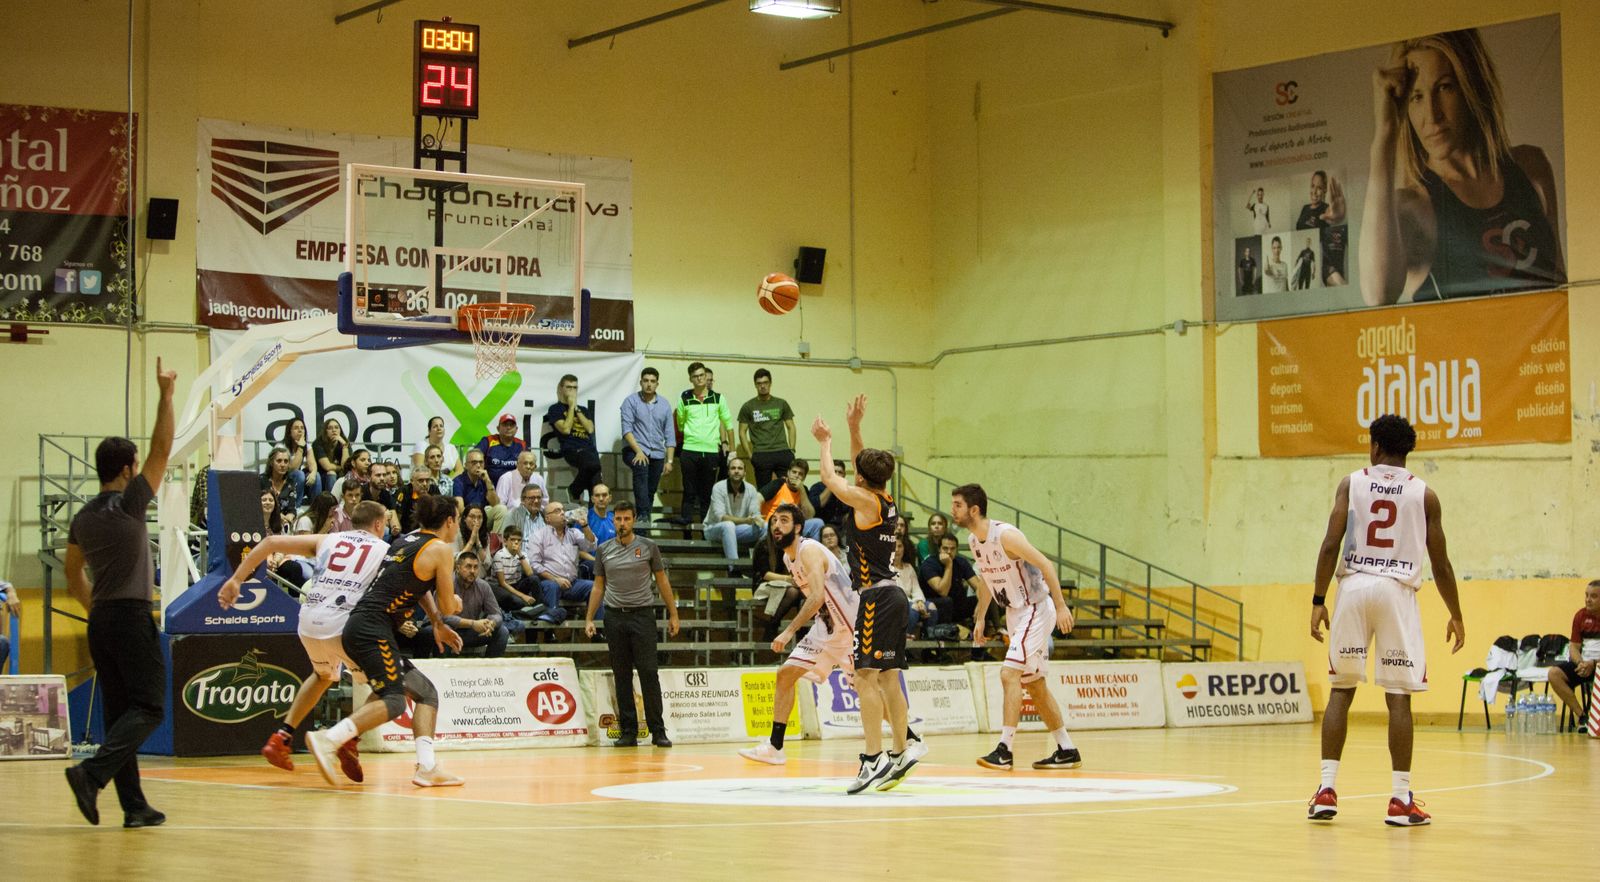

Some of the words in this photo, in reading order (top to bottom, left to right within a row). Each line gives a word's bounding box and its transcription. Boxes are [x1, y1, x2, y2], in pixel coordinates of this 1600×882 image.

[422, 28, 473, 52] 03:04
[422, 64, 472, 107] 24
[357, 176, 619, 217] Chaconstructva
[9, 244, 43, 263] 768
[1357, 317, 1417, 364] agenda
[1530, 339, 1566, 354] edición
[1271, 362, 1299, 375] cultura
[1519, 362, 1544, 377] sitios
[1546, 359, 1566, 374] web
[1270, 382, 1302, 397] deporte
[1357, 355, 1482, 438] atalaya
[1534, 381, 1565, 397] diseño
[1271, 402, 1303, 415] turismo
[1516, 401, 1565, 421] publicidad
[1271, 420, 1314, 435] formación
[1370, 482, 1403, 495] Powell
[1366, 499, 1398, 548] 2
[328, 540, 373, 574] 21
[1345, 553, 1413, 571] JUARISTI
[204, 614, 248, 626] Schelde
[249, 613, 286, 626] Sports
[532, 667, 559, 682] café
[1060, 674, 1092, 685] TALLER
[1094, 672, 1139, 684] MECÁNICO
[196, 669, 297, 712] Fragata
[457, 679, 477, 689] mejor
[494, 677, 505, 687] AB
[1208, 672, 1301, 696] REPSOL
[443, 689, 455, 699] del
[455, 690, 486, 699] tostadero
[493, 690, 500, 698] tu
[501, 689, 516, 698] casa
[661, 690, 700, 699] OCHERAS
[701, 689, 739, 699] REUNIDAS
[1076, 684, 1128, 699] MONTAÑO
[463, 704, 496, 716] Cómpralo
[537, 691, 570, 717] AB
[1186, 702, 1256, 719] HIDEGOMSA
[1258, 699, 1300, 715] MORÓN
[451, 715, 522, 727] www.cafeab.com
[670, 711, 698, 719] Alejandro
[699, 710, 716, 718] Salas
[716, 710, 731, 718] Luna
